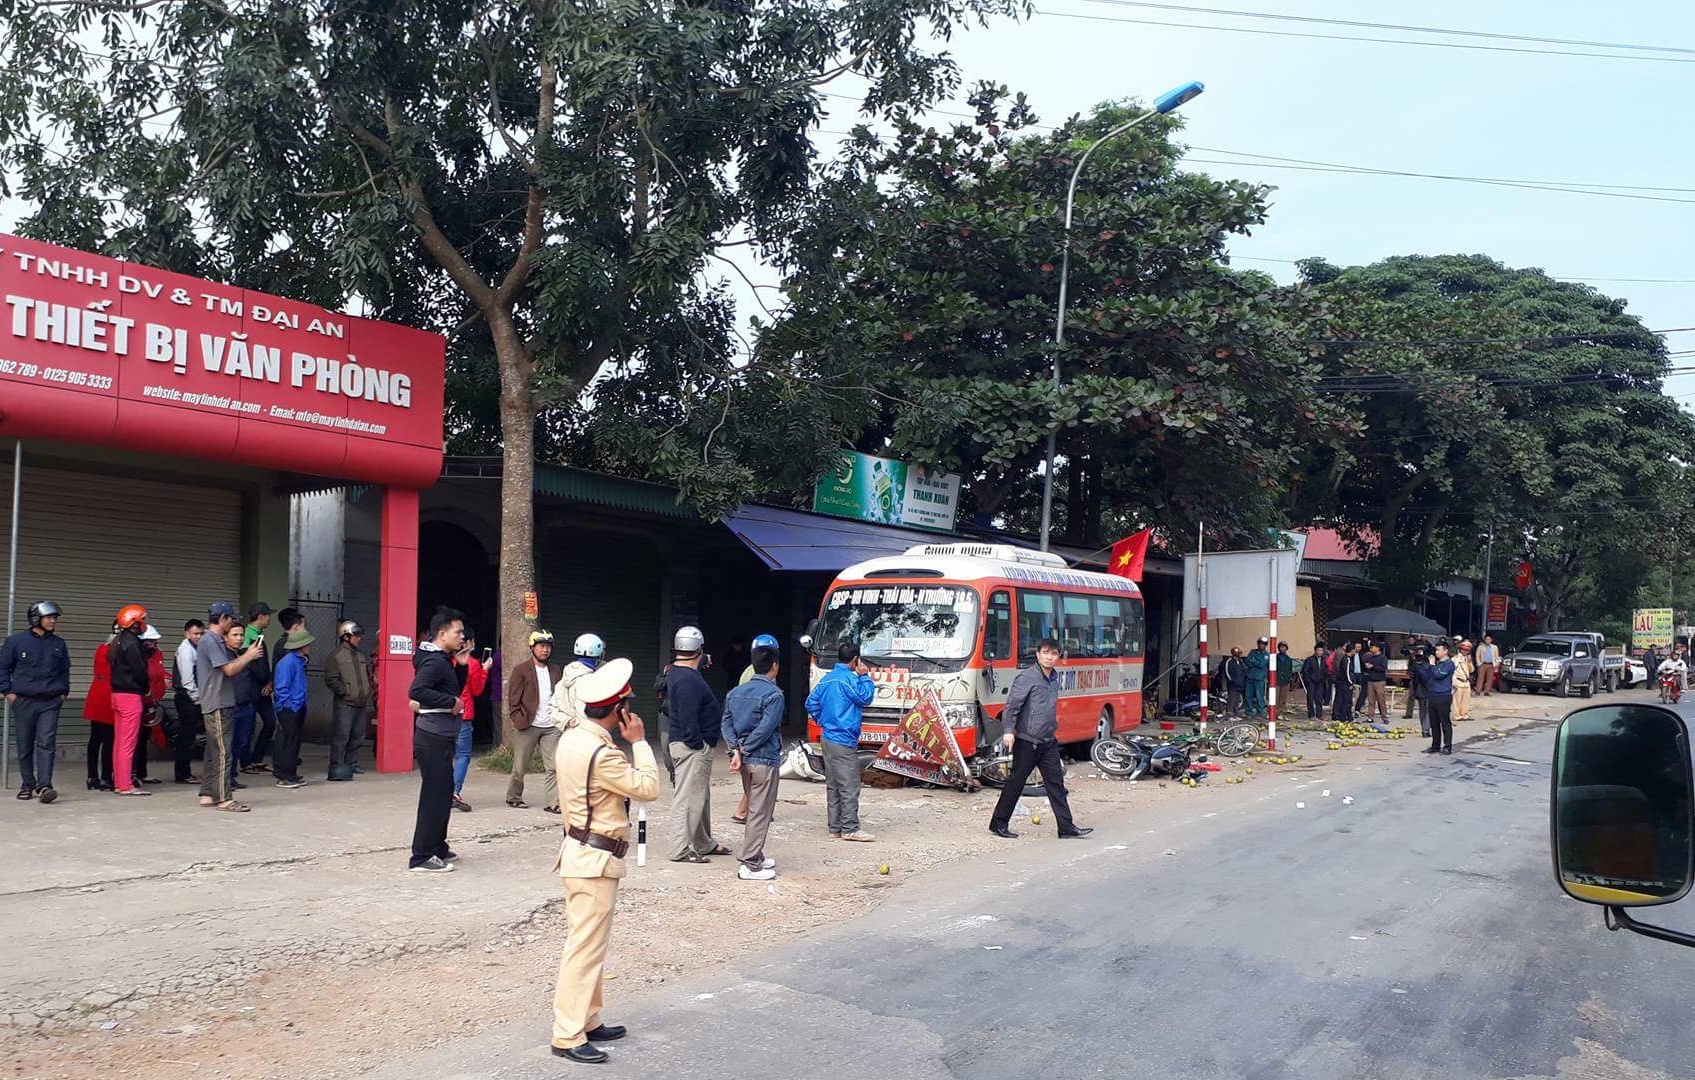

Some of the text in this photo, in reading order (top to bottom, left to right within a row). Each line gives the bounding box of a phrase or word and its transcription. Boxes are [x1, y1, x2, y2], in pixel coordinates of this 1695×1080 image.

[13, 252, 344, 339] TNHH DV & TM ĐẠI AN
[5, 294, 411, 408] THIẾT BỊ VĂN PHÒNG
[17, 362, 38, 377] 789
[43, 367, 68, 383] 0125
[67, 371, 88, 386] 905
[87, 374, 112, 390] 3333
[143, 385, 182, 401] website:
[269, 405, 295, 420] Email:
[869, 664, 910, 682] UÝT
